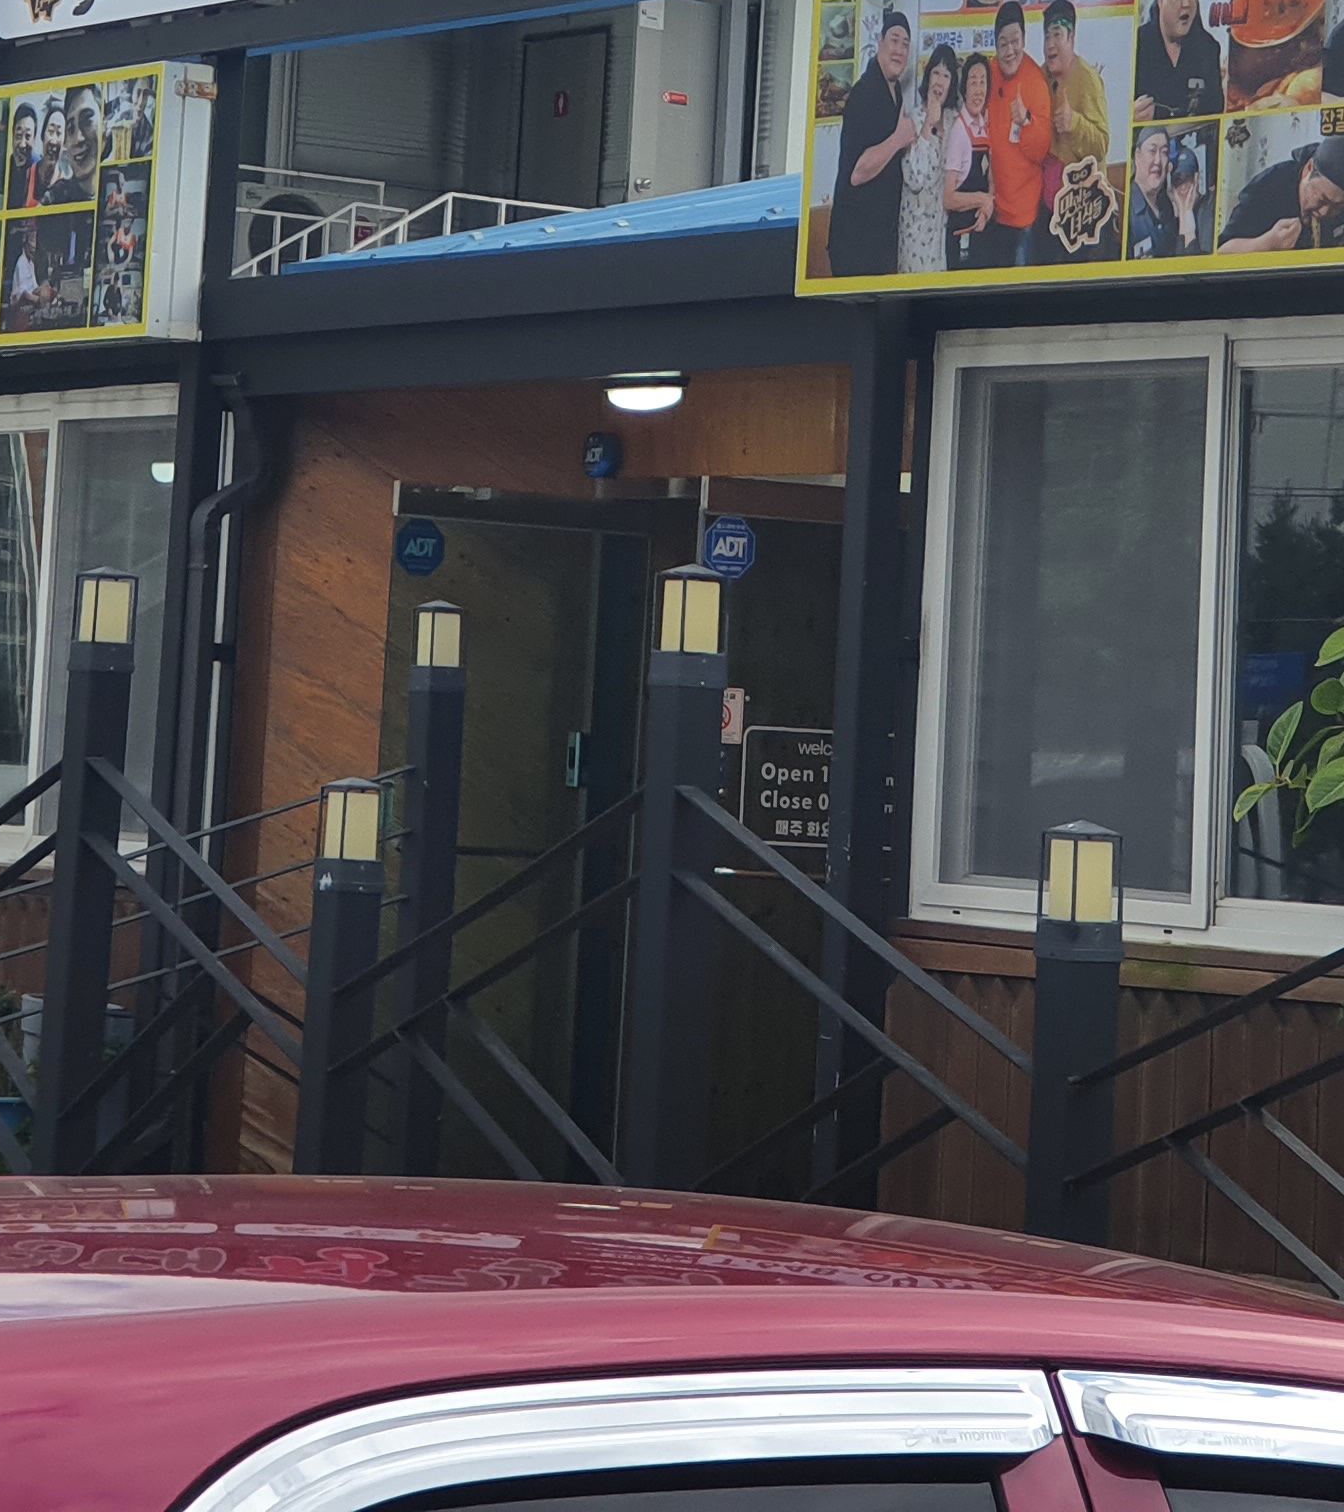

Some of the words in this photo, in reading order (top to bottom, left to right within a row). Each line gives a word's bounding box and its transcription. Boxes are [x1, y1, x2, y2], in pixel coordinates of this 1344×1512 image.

[585, 447, 603, 464] ADT
[405, 538, 437, 558] ADT
[712, 536, 748, 559] ADT
[761, 762, 815, 786] Open
[760, 790, 813, 809] Close
[775, 819, 803, 837] 매주
